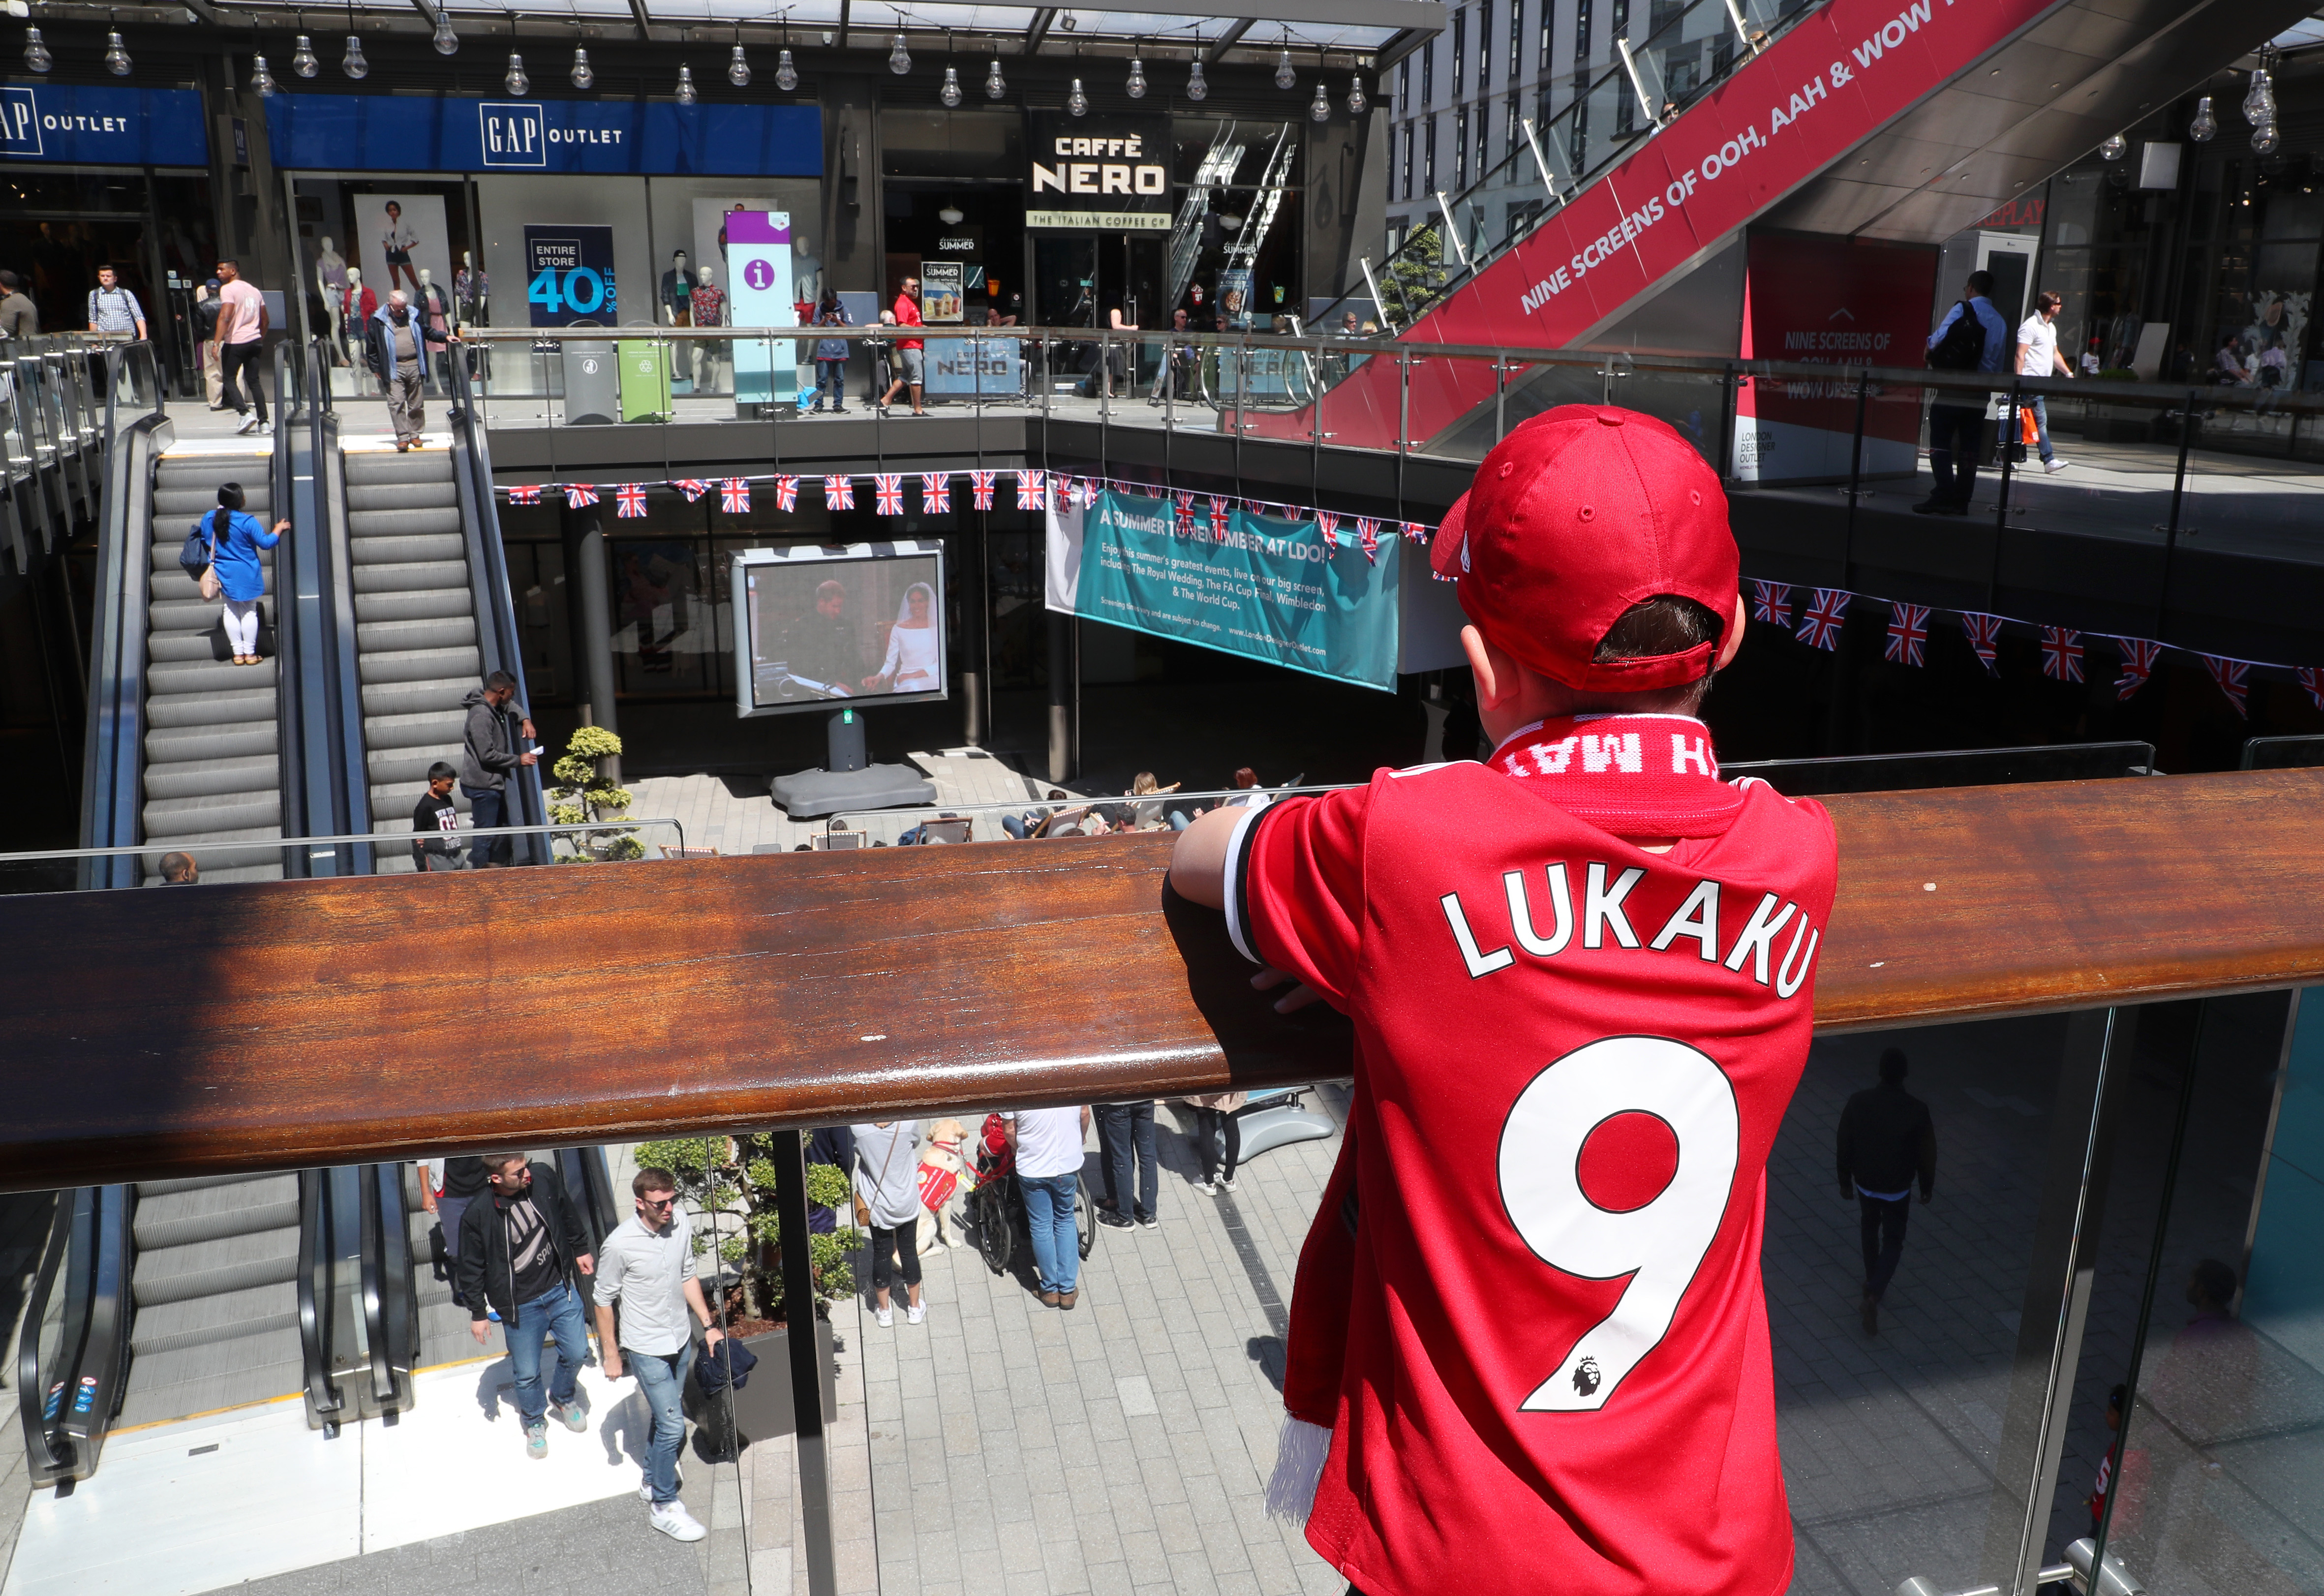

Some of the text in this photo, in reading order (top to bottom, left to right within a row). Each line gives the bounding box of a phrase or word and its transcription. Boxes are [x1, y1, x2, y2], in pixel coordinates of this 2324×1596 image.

[0, 102, 126, 140] AP OUTLET
[489, 117, 622, 153] GAP OUTLET
[1056, 133, 1141, 158] CAFFÈ
[1522, 0, 1932, 315] NINE SCREENS OF OOH, AAH & WOW
[1033, 161, 1164, 195] NERO
[1034, 215, 1052, 223] THE
[1058, 215, 1100, 225] ITALIAN
[1105, 216, 1146, 226] COFFEE
[536, 246, 576, 255] ENTIRE
[939, 242, 975, 250] SUMMER
[1223, 246, 1256, 254] SUMMER
[538, 257, 575, 266] STORE
[926, 268, 958, 276] SUMMER
[528, 266, 605, 314] 40
[1785, 332, 1891, 350] NINE SCREENS OF
[937, 361, 1007, 375] NERO
[1787, 381, 1823, 399] WOW
[1741, 442, 1775, 452] DESIGNER
[1742, 431, 1772, 442] LONDON
[1740, 453, 1766, 463] OUTLET
[1100, 509, 1111, 525] A
[1112, 510, 1165, 536] SUMMER
[1266, 538, 1286, 557] AT
[1288, 541, 1325, 564] LDO!
[1102, 542, 1325, 596] Enjoy this summer's greatest events, live on our big screen,
[1101, 556, 1326, 612] including The Royal Wedding, The FA Cup Final, Wimbledon
[1172, 586, 1240, 611] & The World Cup.
[1101, 596, 1125, 610] Screening
[1126, 602, 1139, 612] times
[1140, 608, 1150, 617] vary
[1151, 610, 1161, 618] and
[1172, 614, 1192, 625] subject
[1201, 620, 1222, 632] change.
[1228, 627, 1326, 656] www.LondonDesignerOutlet.com
[1439, 860, 1819, 1000] LUKAKU
[1496, 1033, 1741, 1412] 9
